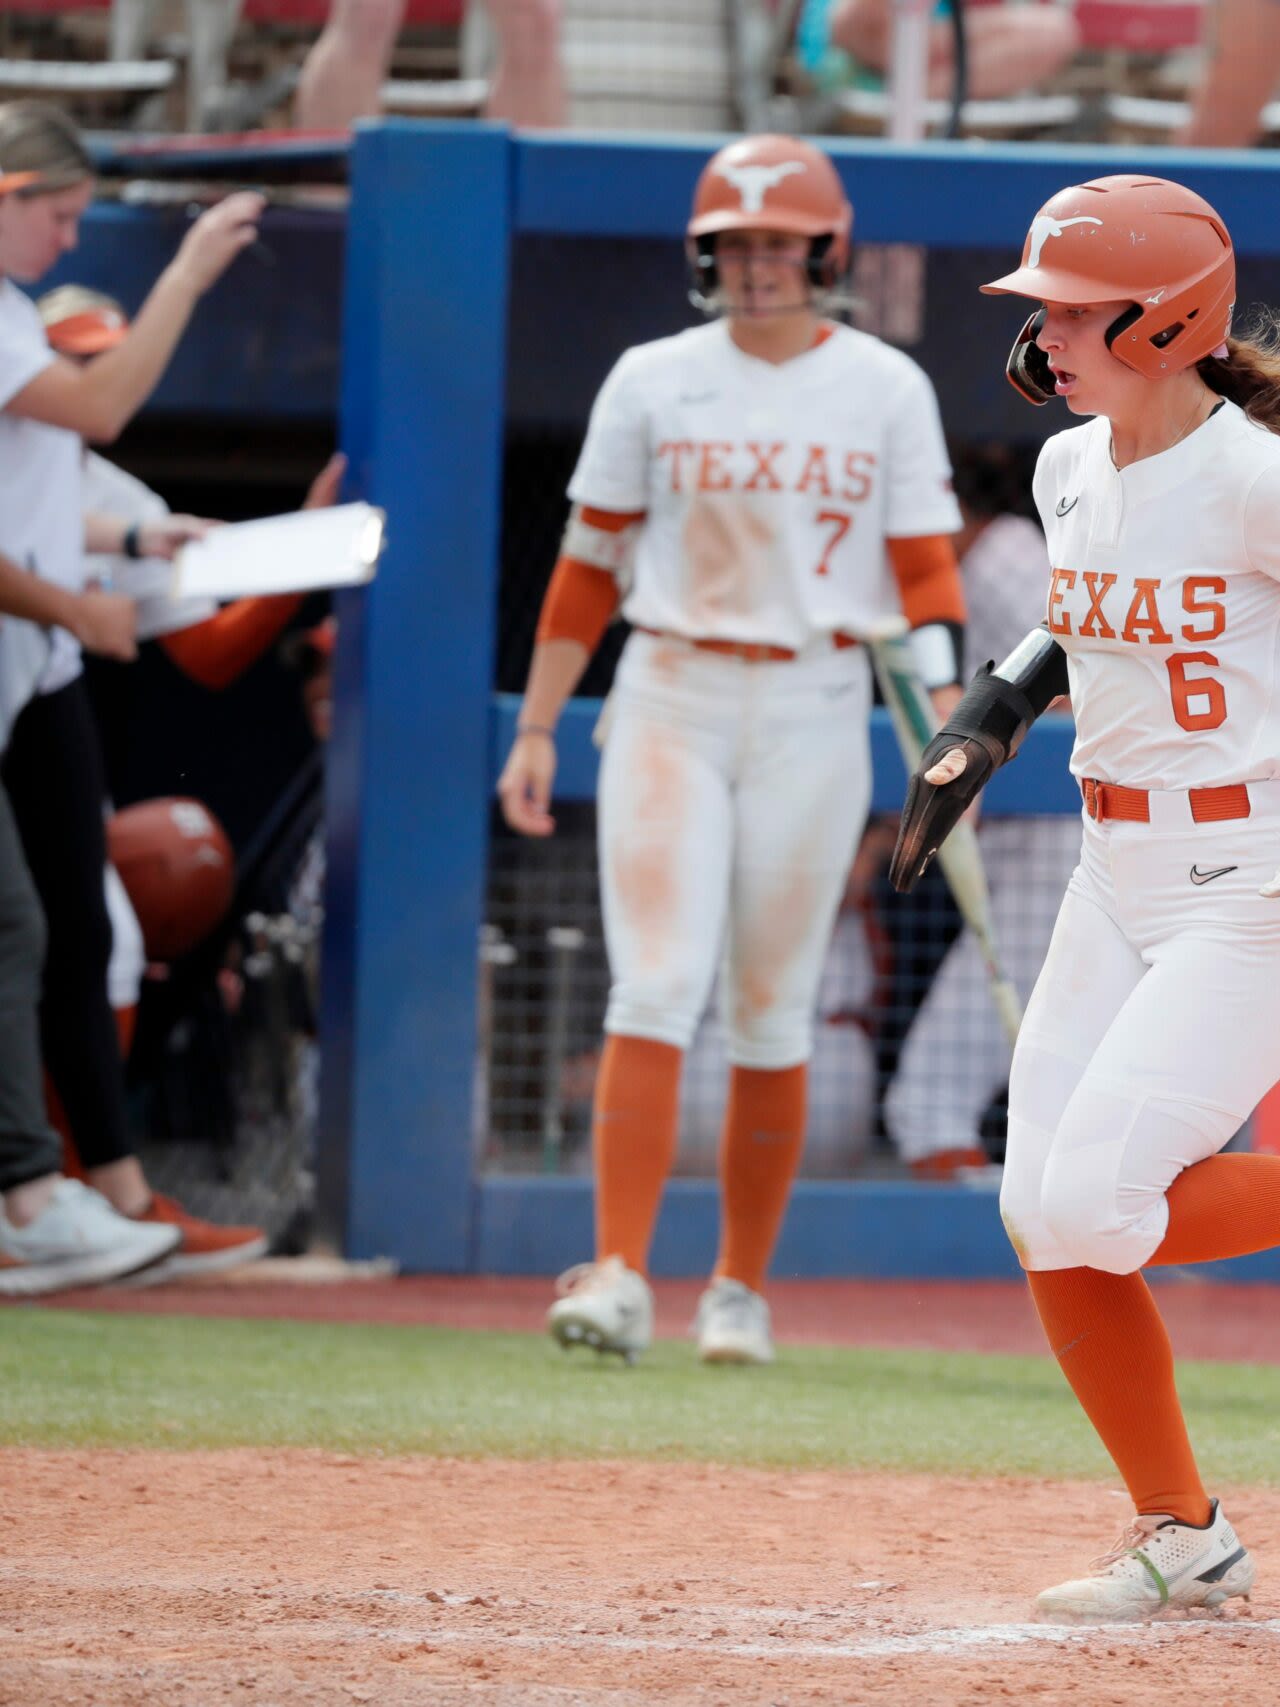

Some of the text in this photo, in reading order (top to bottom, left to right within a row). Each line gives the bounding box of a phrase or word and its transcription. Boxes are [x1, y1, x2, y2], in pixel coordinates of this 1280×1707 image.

[658, 440, 877, 503] TEXAS
[815, 508, 853, 577] 7
[1165, 651, 1227, 732] 6
